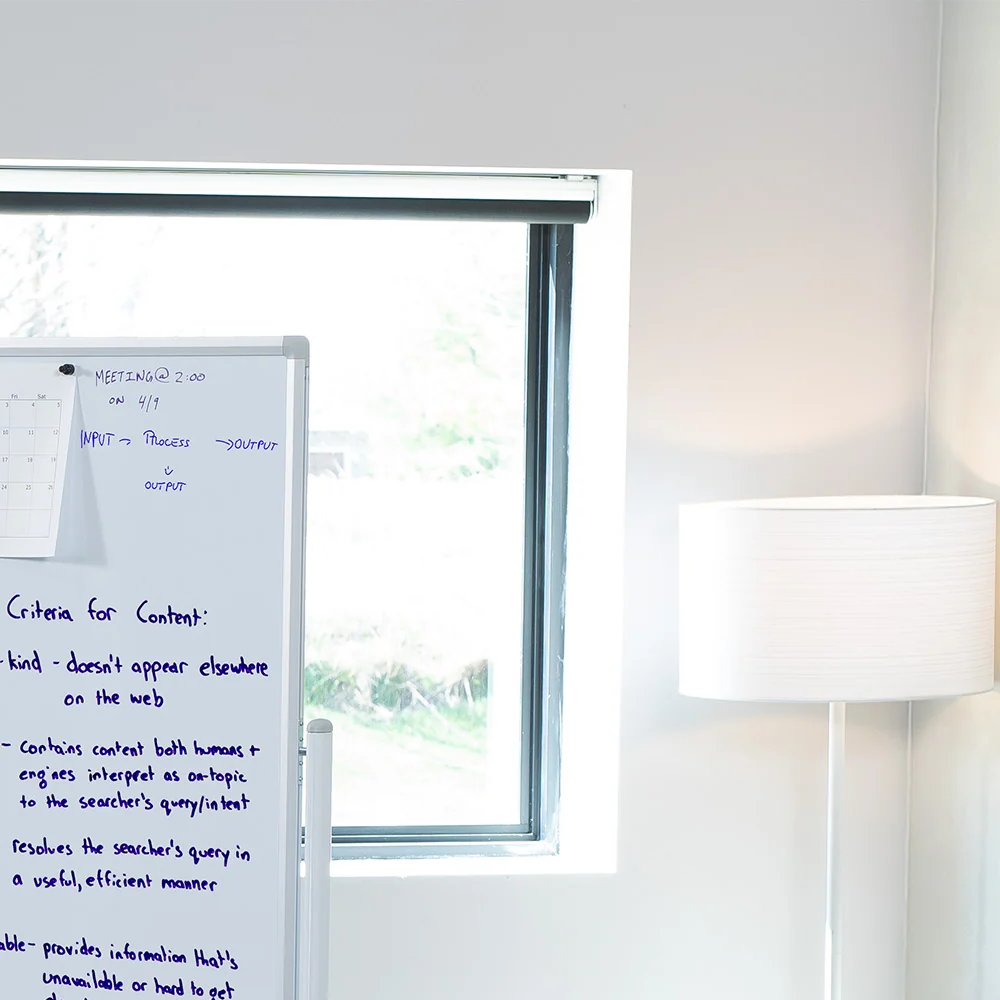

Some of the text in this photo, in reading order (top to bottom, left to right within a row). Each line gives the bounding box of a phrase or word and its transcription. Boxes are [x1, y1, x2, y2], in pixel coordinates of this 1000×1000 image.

[175, 372, 205, 383] 2:00
[109, 395, 159, 412] ON 4/9
[81, 430, 115, 448] INPUT
[235, 439, 278, 450] OUTPUT
[145, 481, 186, 491] OUTPUT
[7, 594, 73, 621] Criteria
[88, 597, 117, 621] for
[137, 600, 207, 627] Content:
[66, 651, 123, 674] doesn't
[131, 661, 188, 682] appear
[199, 655, 268, 676] elsewhere
[64, 688, 163, 707] on the web
[20, 737, 82, 756] contains
[92, 741, 144, 756] content
[154, 737, 187, 757] both
[194, 740, 244, 758] humans
[19, 766, 75, 789] engines
[88, 765, 155, 787] interpret
[164, 771, 180, 782] as
[20, 791, 250, 818] to the searcher's query/intent
[13, 837, 73, 855] resolves
[82, 837, 103, 854] the
[113, 839, 183, 858] searcher's
[189, 847, 230, 867] query
[236, 845, 250, 861] in
[13, 869, 217, 892] a useful, efficient manner
[43, 937, 101, 959] provides
[110, 943, 186, 963] information
[194, 949, 238, 970] that's
[43, 969, 123, 991] unavailable
[132, 982, 147, 992] or
[154, 977, 184, 996] hard
[191, 981, 204, 996] to
